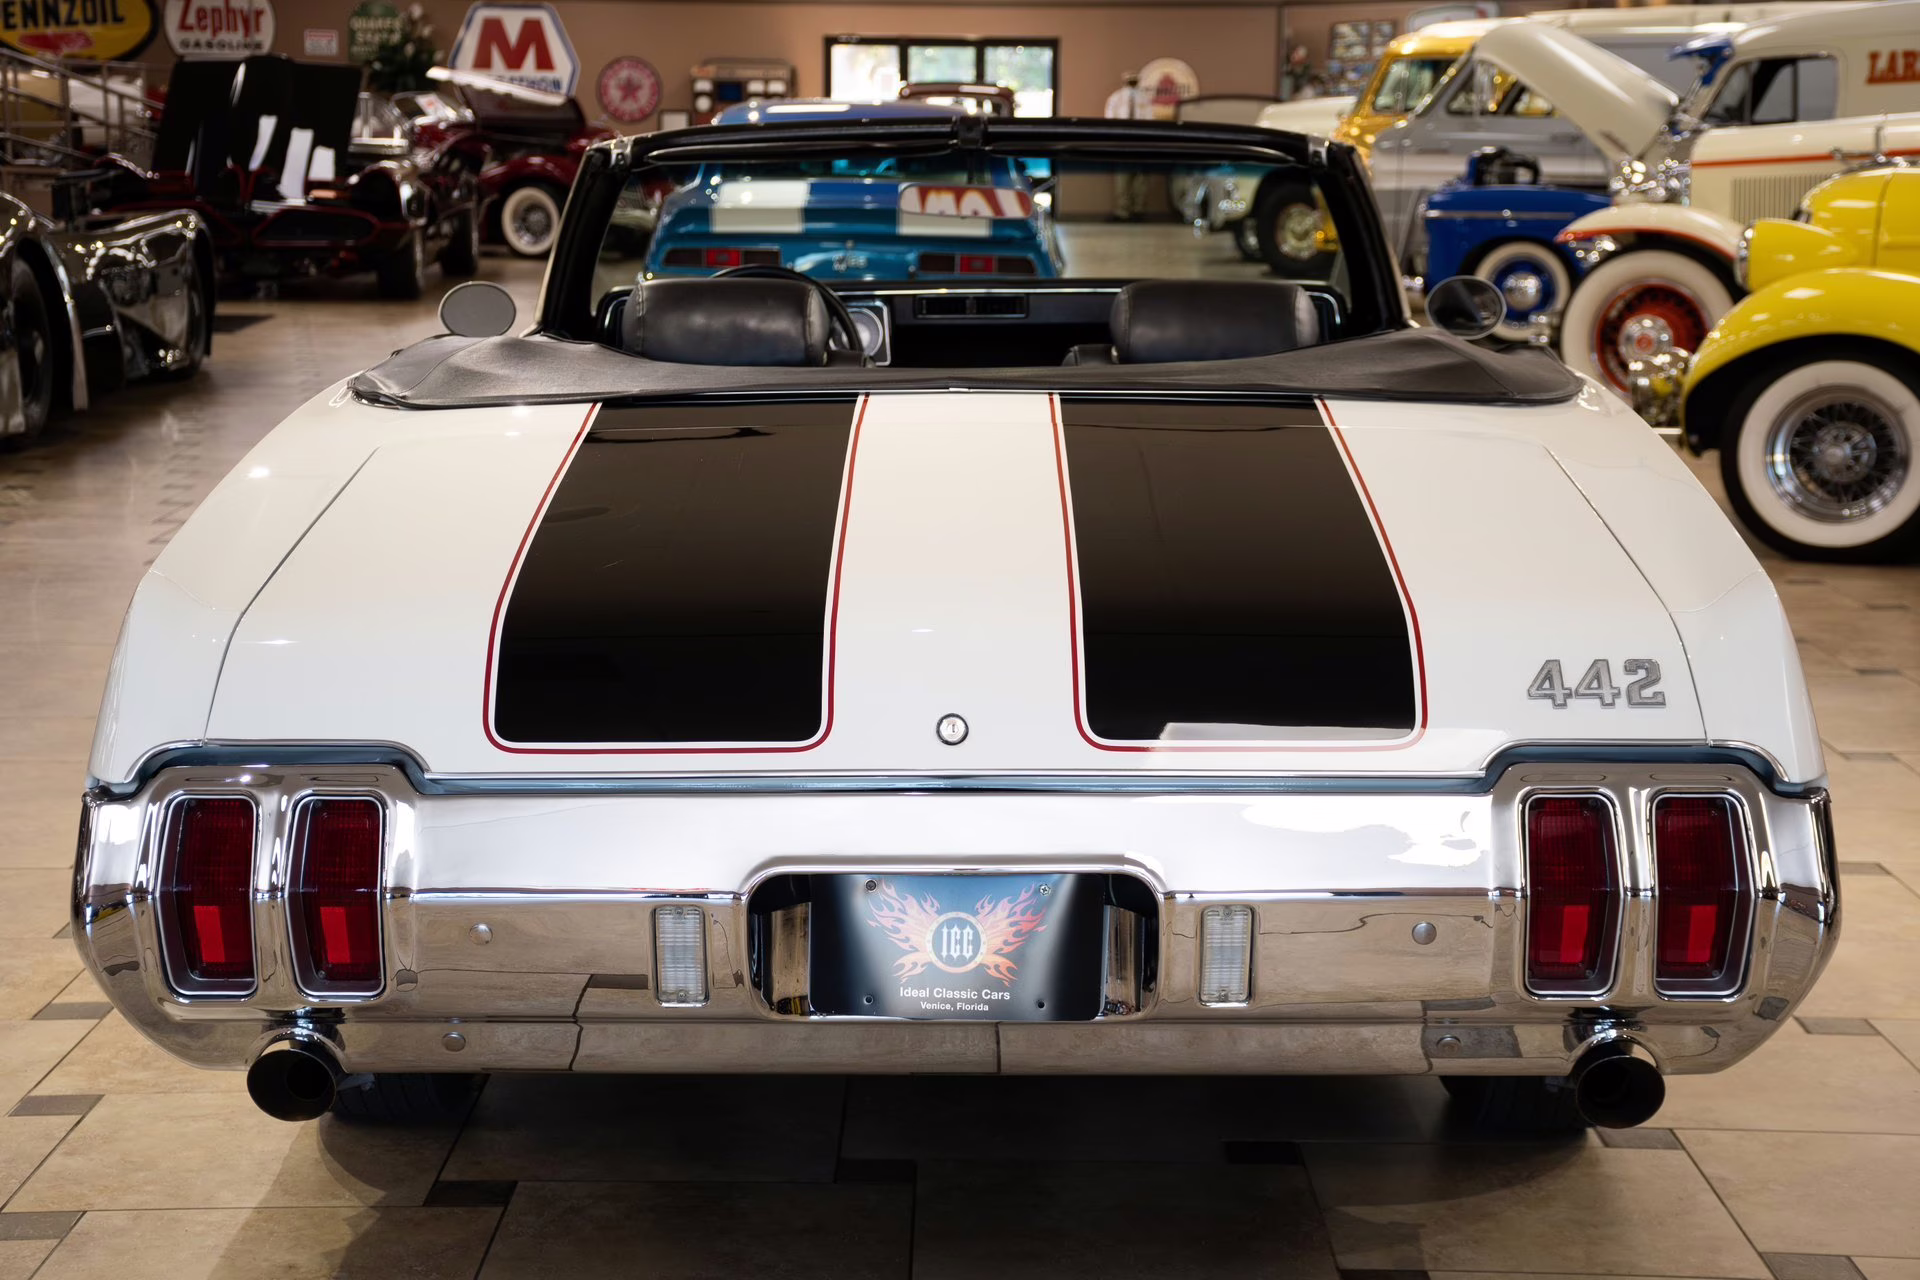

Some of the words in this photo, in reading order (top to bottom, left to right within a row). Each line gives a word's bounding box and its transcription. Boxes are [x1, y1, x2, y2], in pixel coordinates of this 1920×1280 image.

[3, 0, 125, 29] ENNZOIL
[177, 0, 265, 39] Zephyr
[180, 38, 263, 51] GASOLINE
[472, 17, 555, 71] M
[1528, 659, 1666, 708] 442
[900, 986, 930, 998] Ideal
[933, 987, 978, 1000] Classic
[982, 989, 1011, 1000] Cars
[920, 1001, 954, 1011] Venice,
[956, 1001, 989, 1011] Florida
